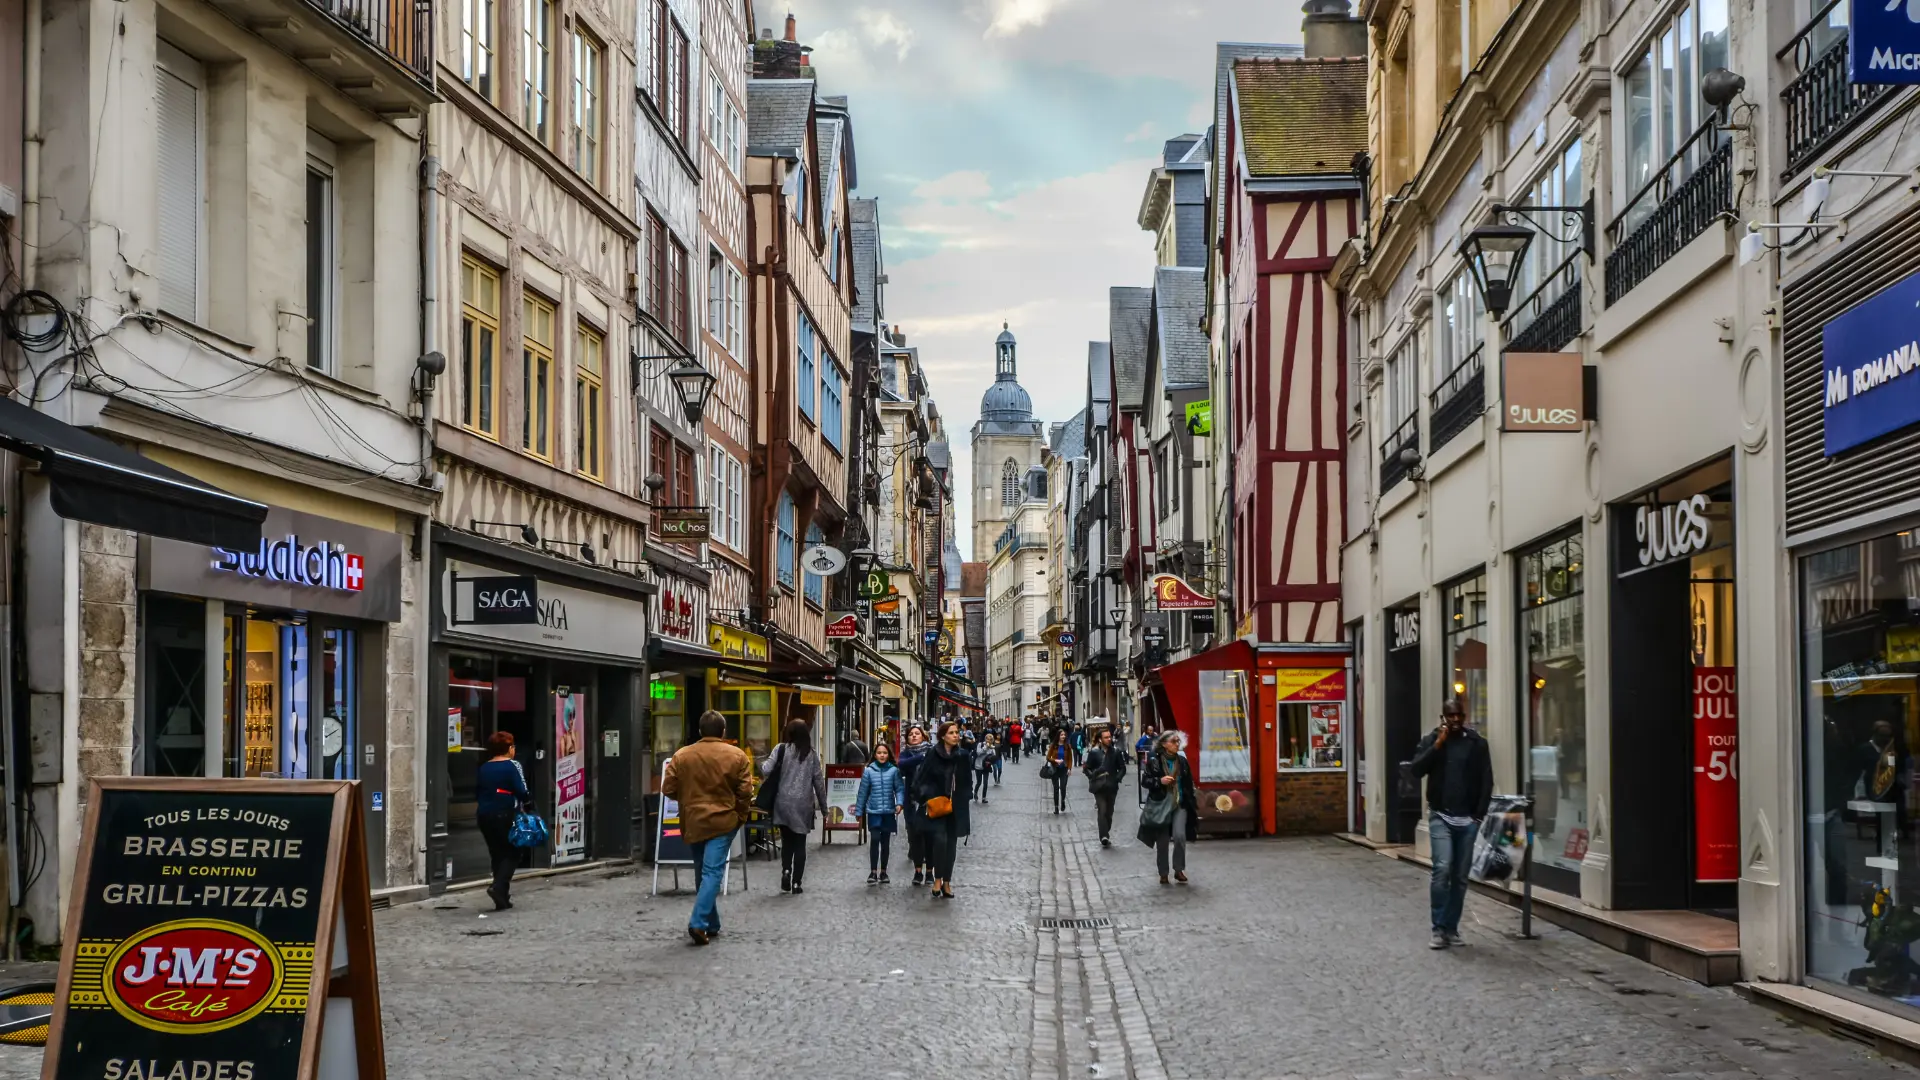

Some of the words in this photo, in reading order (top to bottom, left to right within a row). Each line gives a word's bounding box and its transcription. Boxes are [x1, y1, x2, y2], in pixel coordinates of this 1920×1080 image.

[1853, 341, 1920, 396] ROMANIA
[478, 588, 532, 608] SAGA
[537, 598, 568, 631] SAGA
[1708, 735, 1736, 746] TOUT
[144, 809, 190, 829] TOUS
[196, 808, 229, 821] LES
[233, 809, 290, 831] JOURS
[123, 836, 303, 859] BRASSERIE
[161, 865, 182, 876] EN
[188, 865, 257, 877] CONTINU
[102, 883, 308, 908] GRILL-PIZZAS
[144, 989, 229, 1017] Café
[104, 1057, 255, 1080] SALADES
